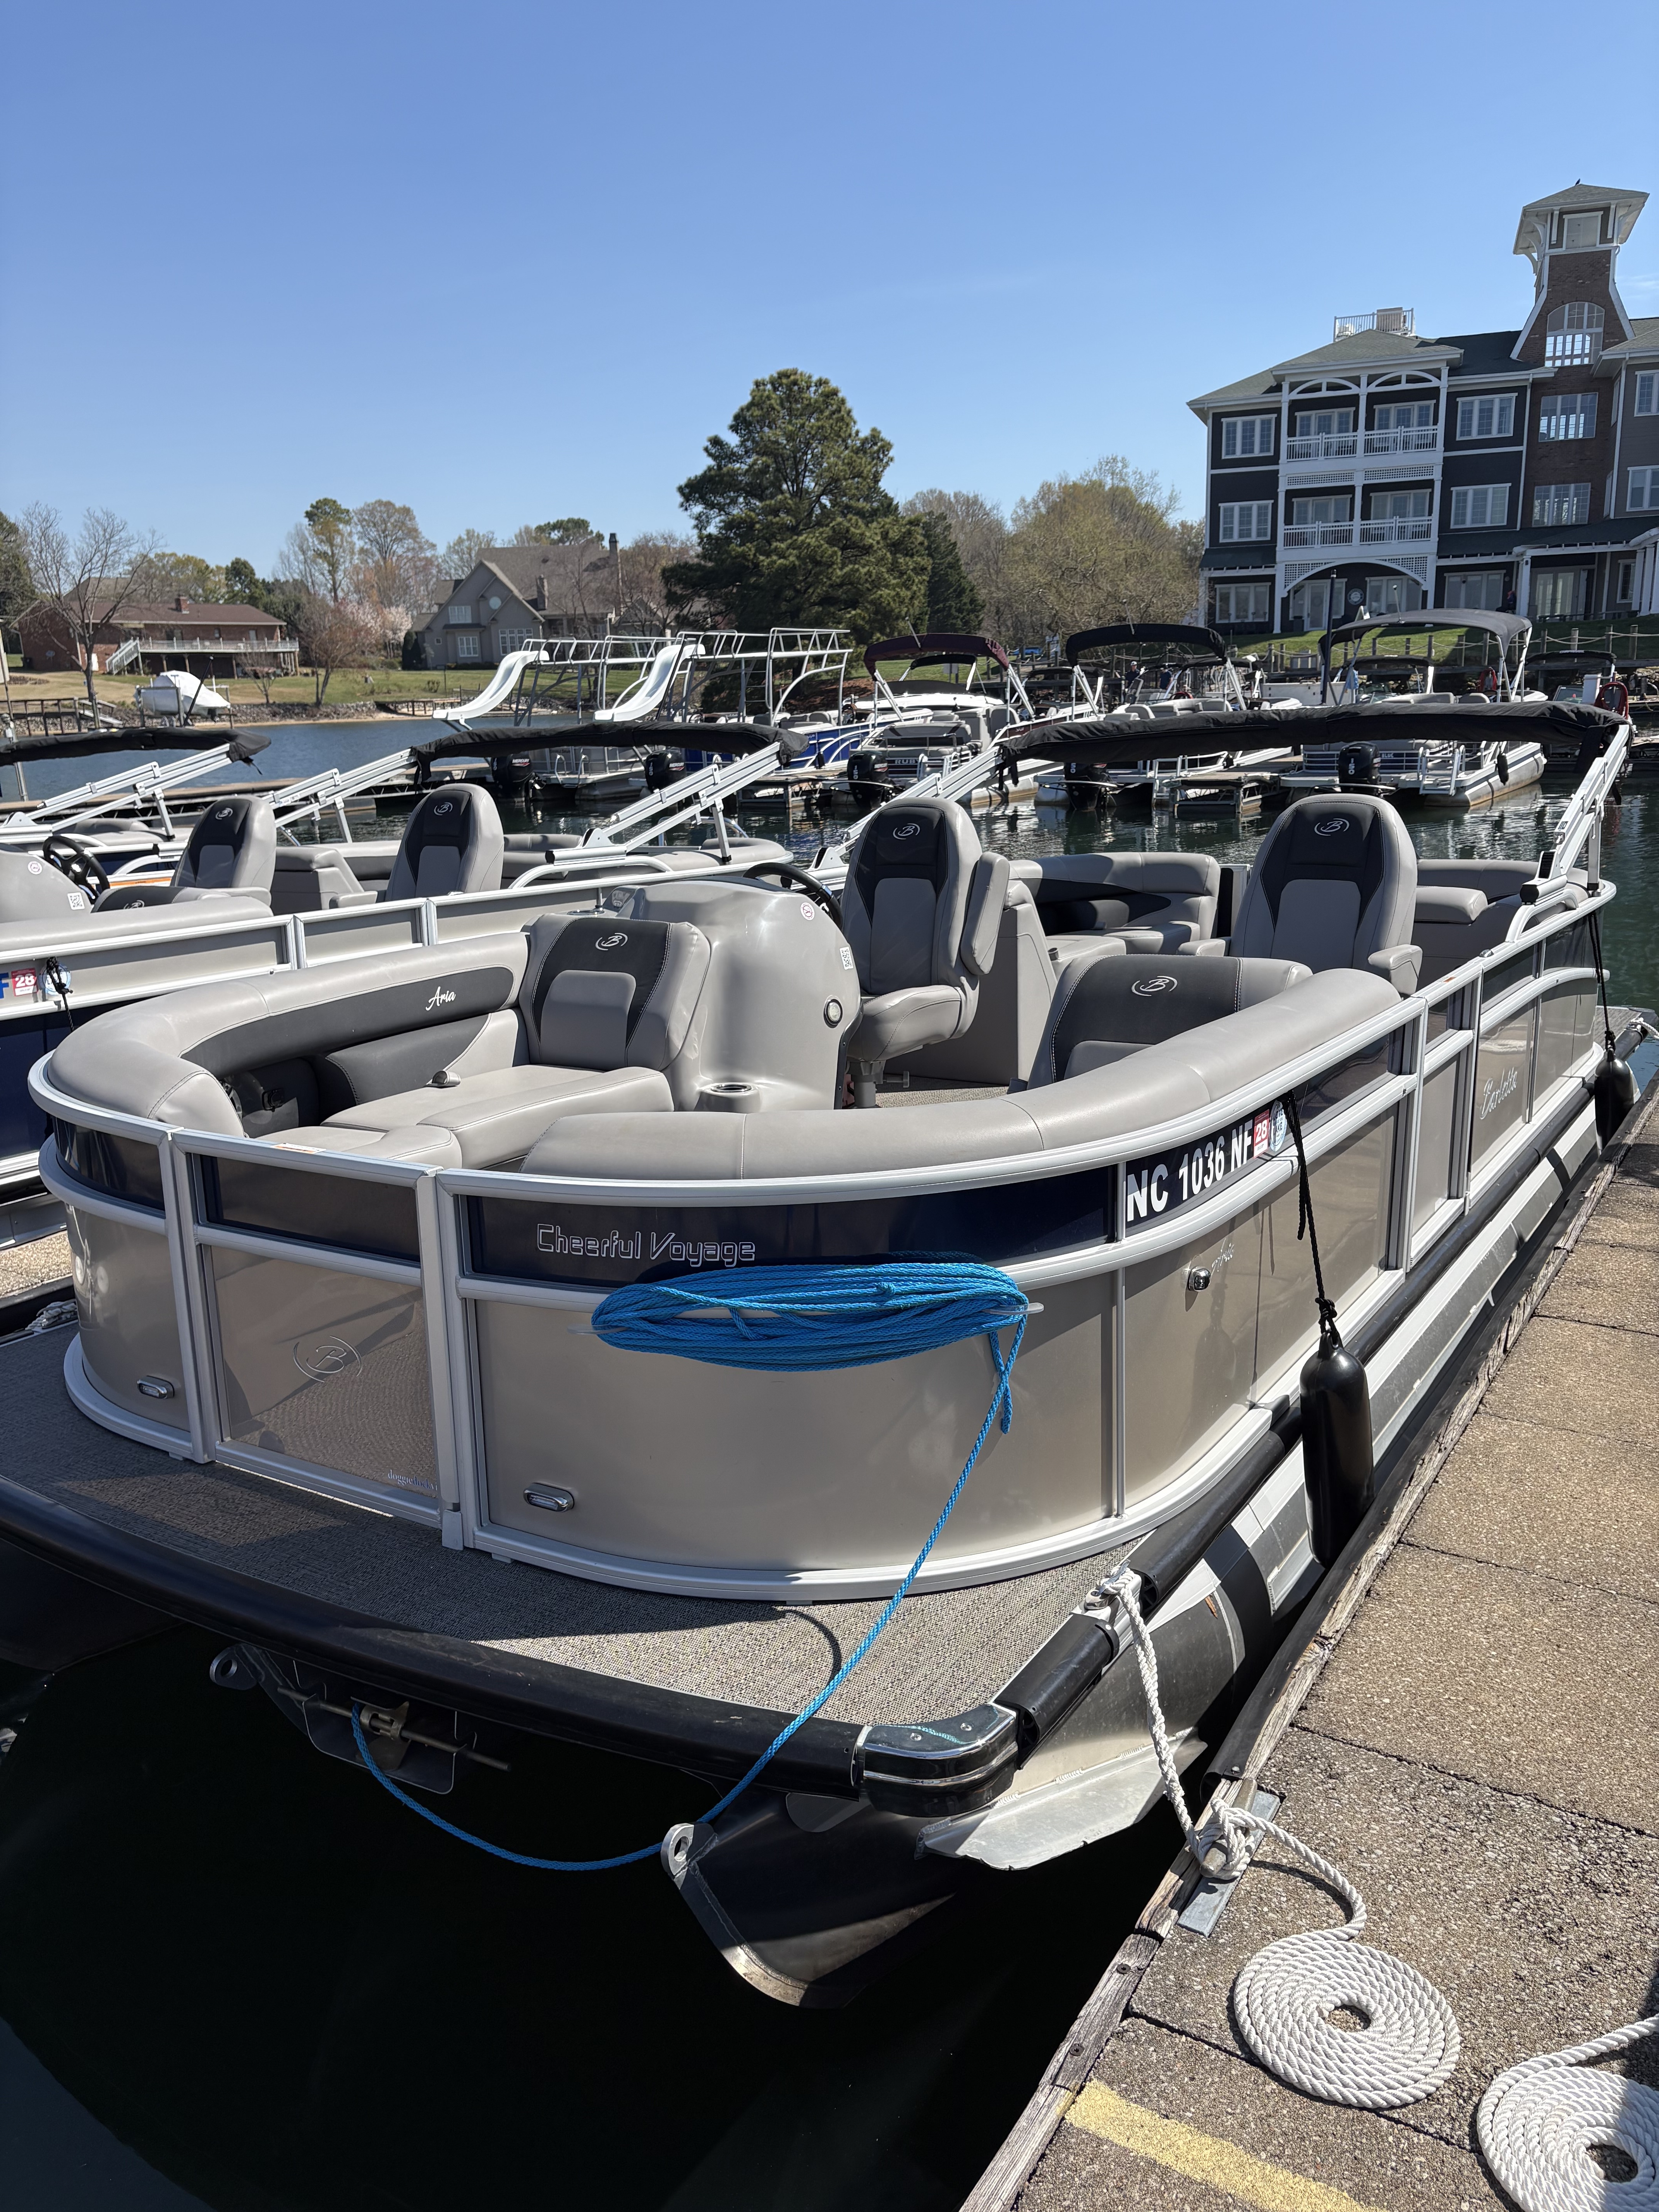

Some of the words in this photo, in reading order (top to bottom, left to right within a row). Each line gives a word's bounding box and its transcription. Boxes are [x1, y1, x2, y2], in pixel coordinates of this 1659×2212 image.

[15, 973, 35, 988] 28
[426, 986, 456, 1011] Aria
[1255, 1119, 1267, 1144] 28
[1127, 1164, 1168, 1222] NC
[1179, 1136, 1225, 1200] 1036
[1231, 1119, 1253, 1172] NF
[537, 1224, 641, 1259] Cheerful
[650, 1232, 755, 1267] Voyage
